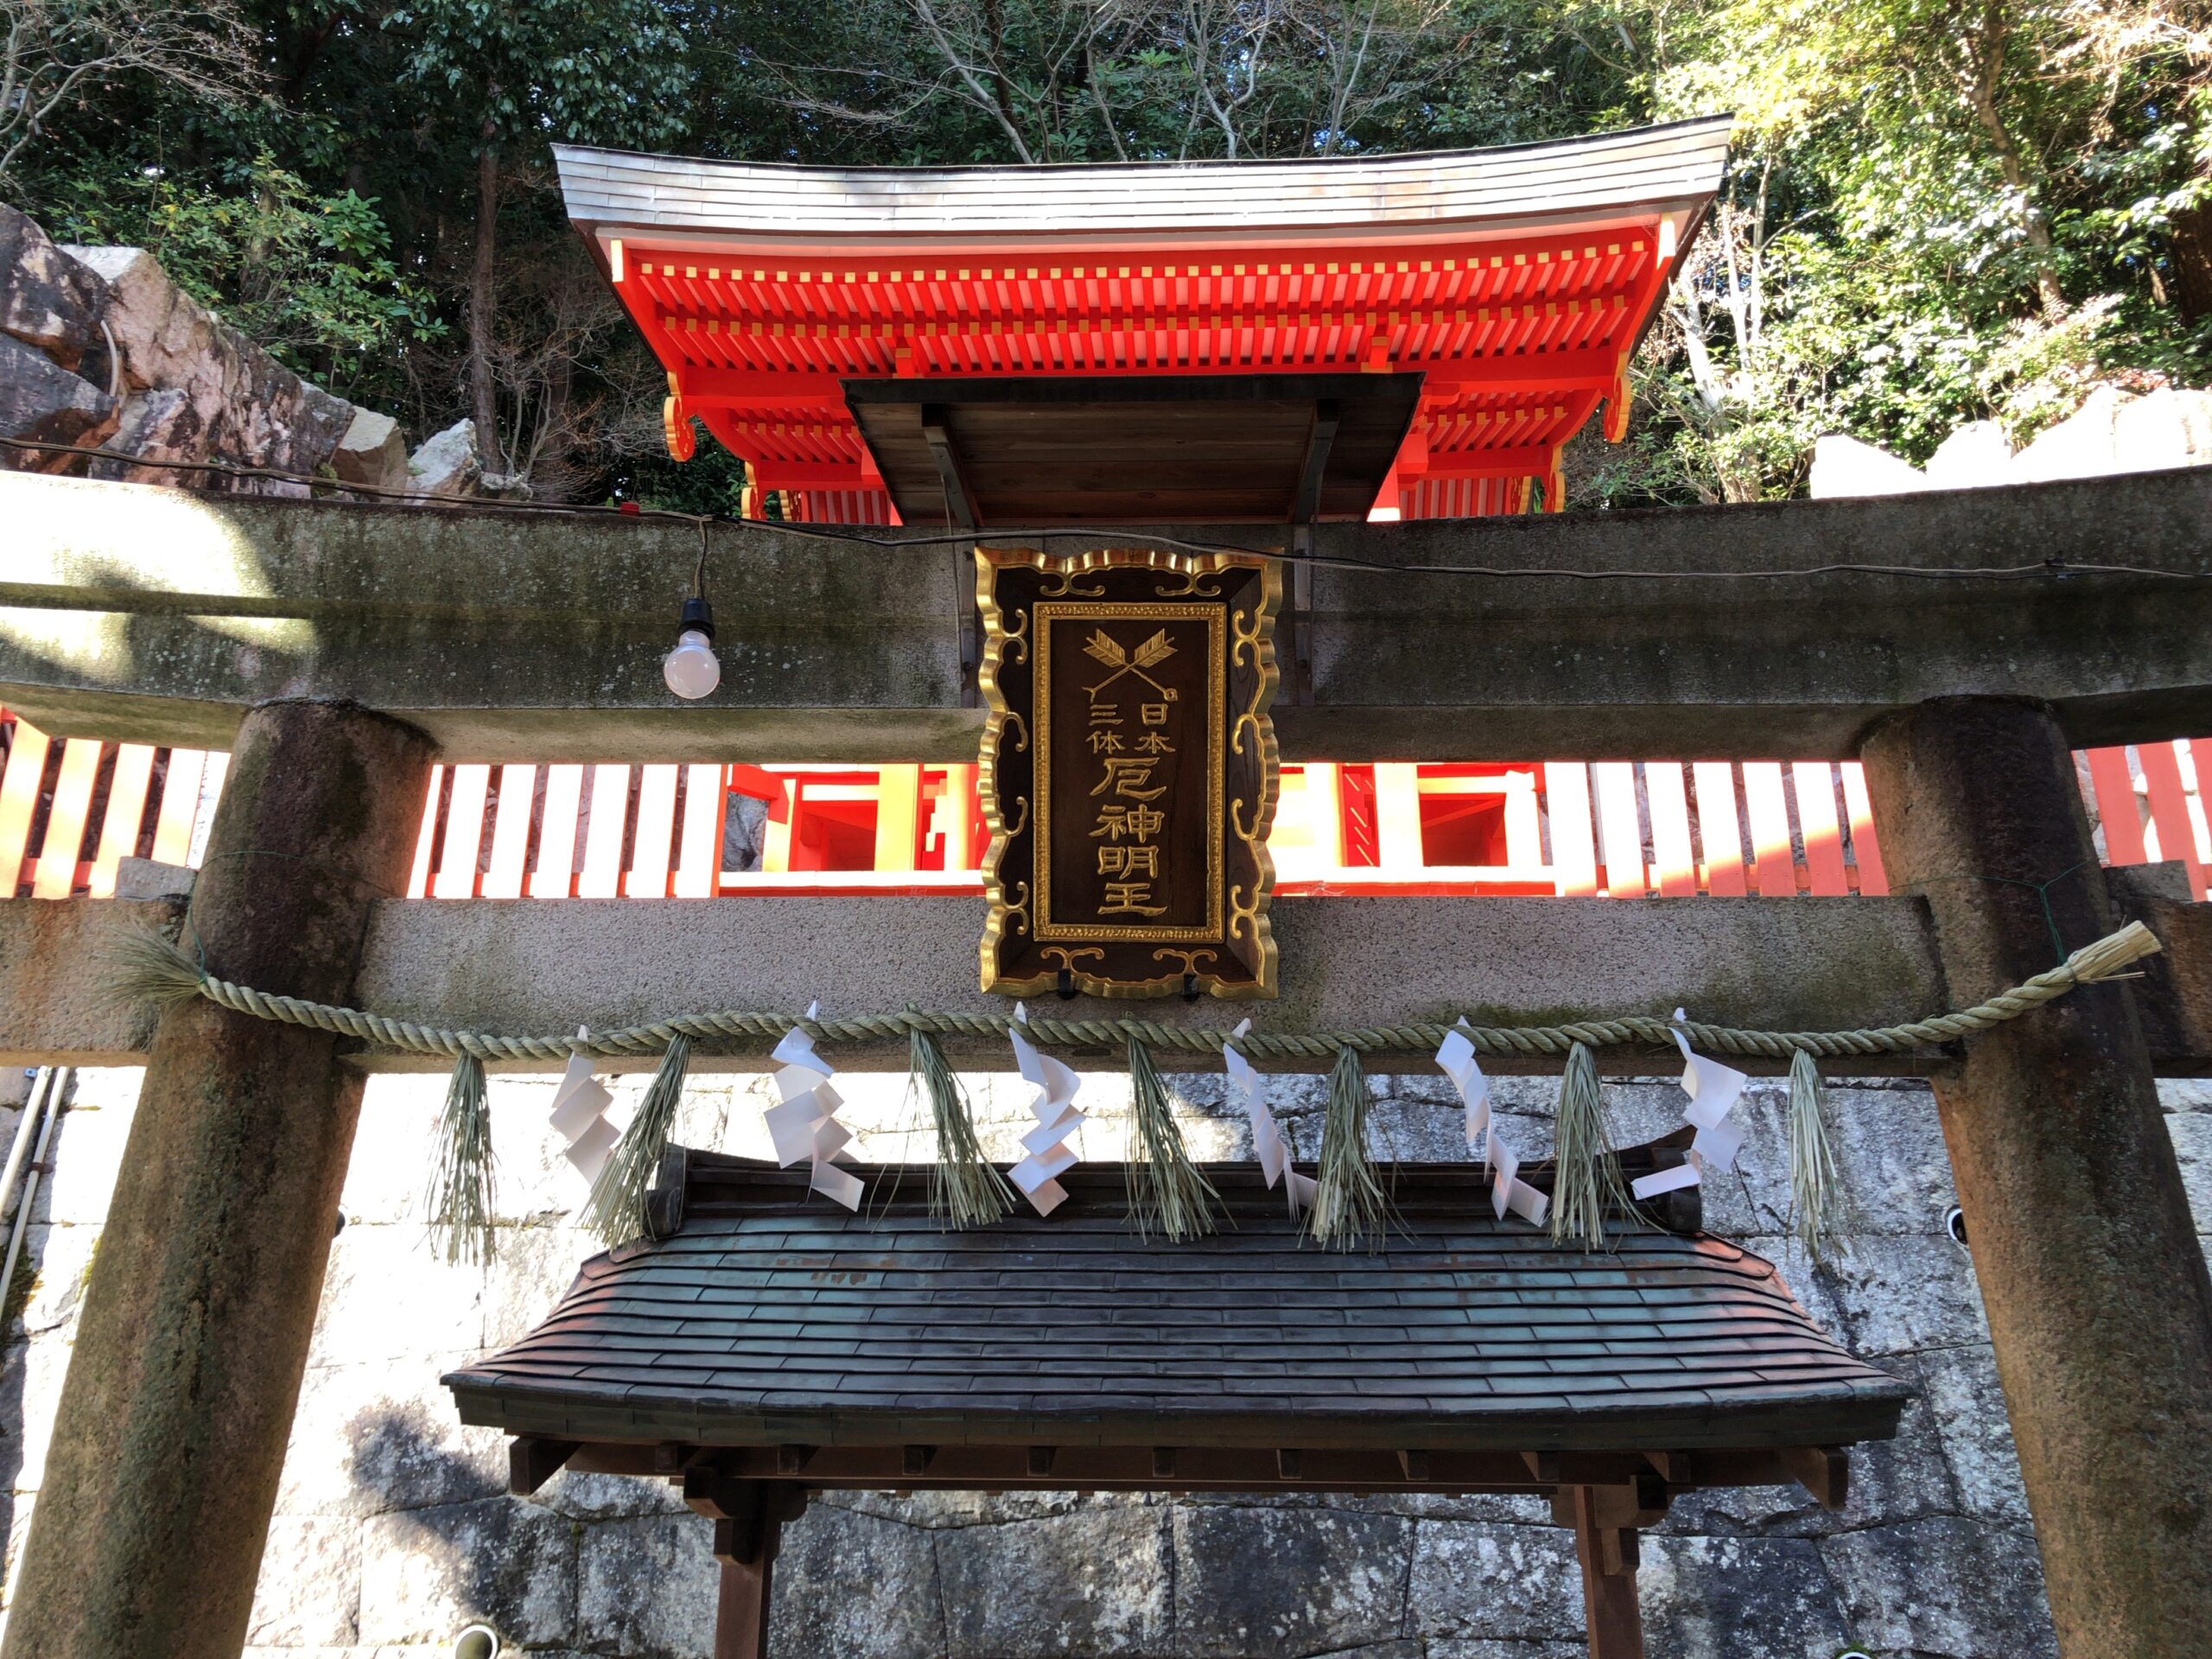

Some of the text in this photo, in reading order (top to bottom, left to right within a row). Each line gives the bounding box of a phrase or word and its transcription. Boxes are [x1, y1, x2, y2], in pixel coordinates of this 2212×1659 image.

[1085, 703, 1125, 754] 三体
[1135, 702, 1175, 753] 日本
[1089, 757, 1167, 916] 厄神明王
